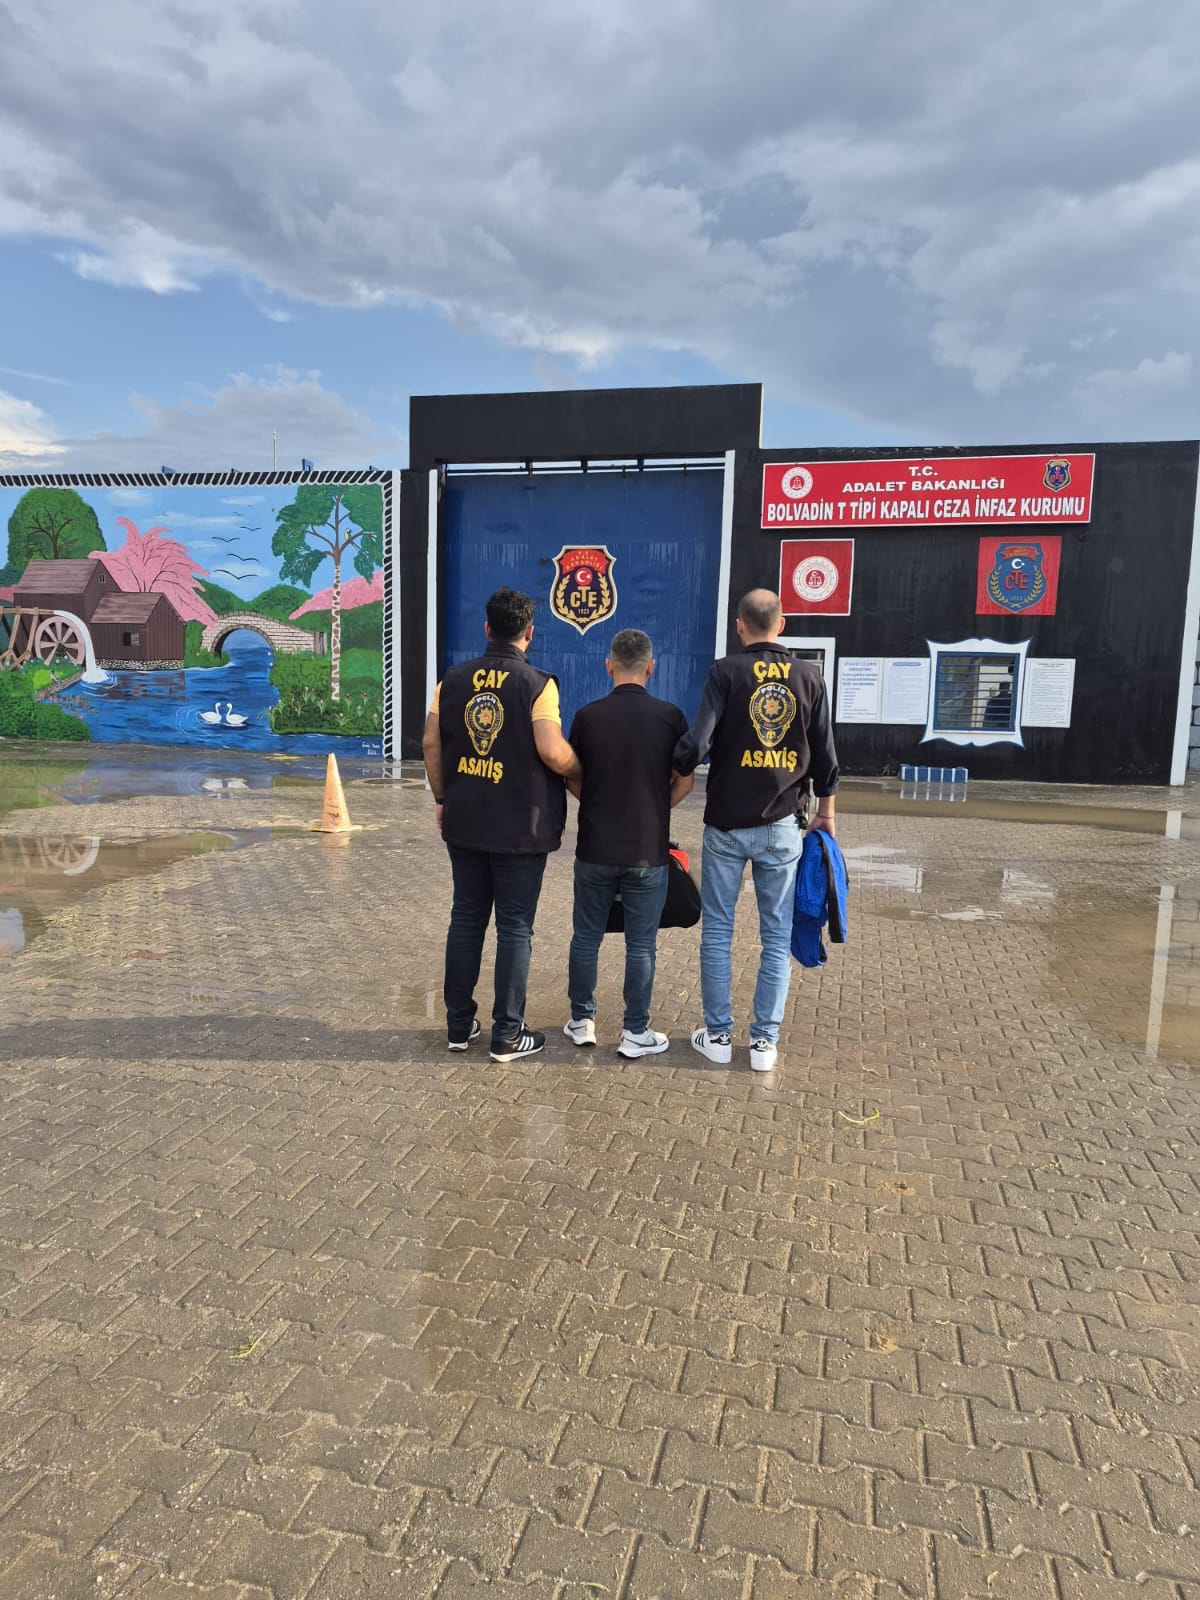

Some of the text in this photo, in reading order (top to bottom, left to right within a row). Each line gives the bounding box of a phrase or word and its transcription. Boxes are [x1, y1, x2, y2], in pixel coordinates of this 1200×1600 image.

[908, 465, 938, 477] T.C.
[842, 476, 1005, 493] ADALET BAKANLIĞI
[767, 494, 1085, 522] BOLVADİN T TİPİ KAPALI CEZA İNFAZ KURUMU
[1004, 570, 1029, 590] CTE
[570, 586, 597, 608] CTE
[472, 668, 510, 692] ÇAY
[753, 660, 792, 683] ÇAY
[457, 756, 504, 784] ASAYİŞ
[741, 747, 798, 773] ASAYİŞ
